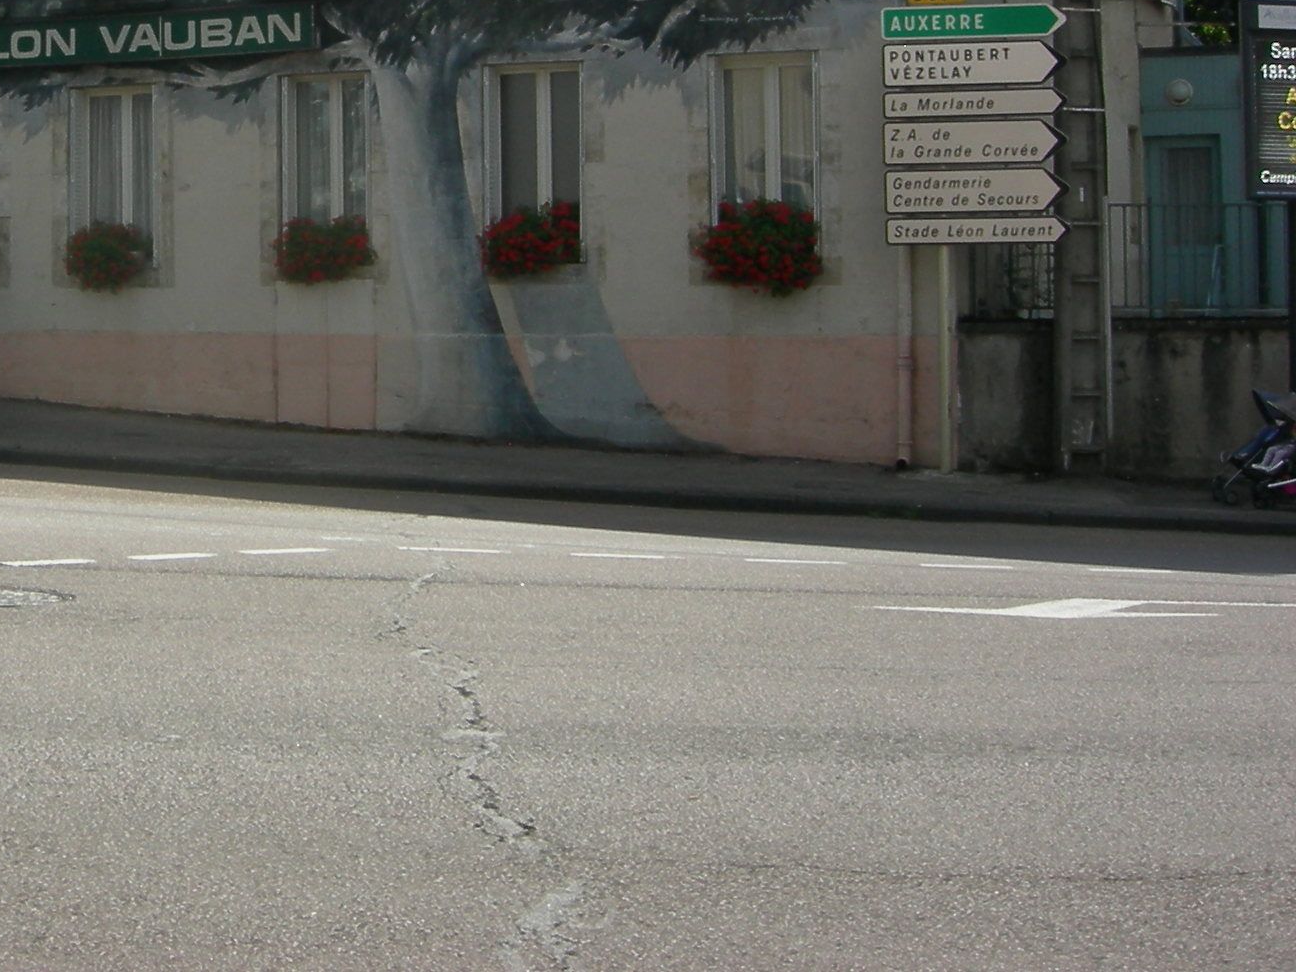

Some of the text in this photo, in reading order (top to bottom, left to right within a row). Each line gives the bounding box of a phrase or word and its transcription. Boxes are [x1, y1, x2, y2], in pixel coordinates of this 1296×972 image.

[890, 13, 984, 32] AUXERRE
[100, 12, 301, 54] VAUBAN
[890, 48, 1010, 63] PONTAUBERT
[890, 97, 995, 112] La Morlande
[890, 129, 950, 142] Z.A. de
[890, 144, 1039, 159] la Grande Corvée
[893, 177, 991, 190] Gendarmerie
[893, 193, 1039, 208] Centre de Secours
[894, 224, 1054, 238] Stade Léon Laurent
